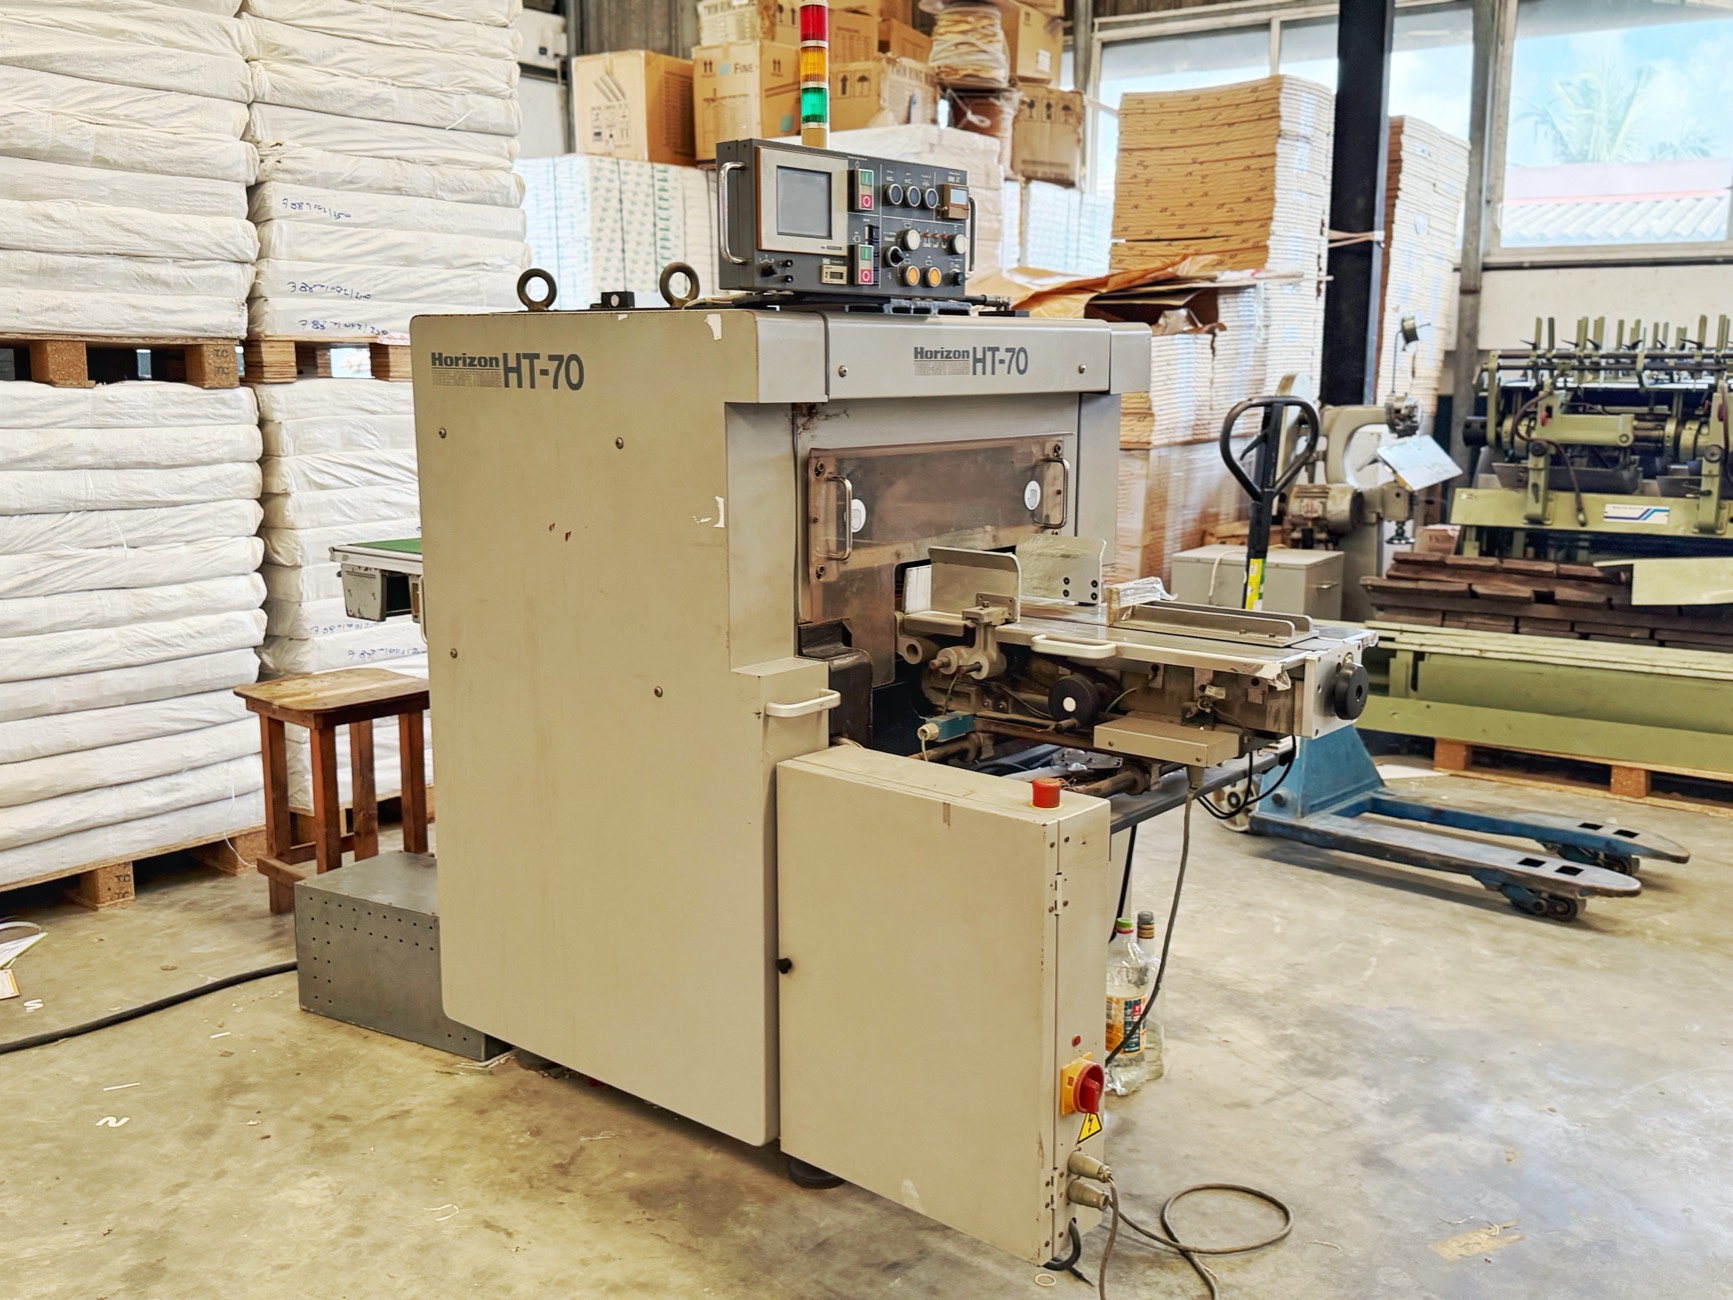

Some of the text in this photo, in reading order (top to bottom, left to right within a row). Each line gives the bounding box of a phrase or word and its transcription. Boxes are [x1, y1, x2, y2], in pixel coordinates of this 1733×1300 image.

[431, 352, 500, 368] Horizon
[502, 352, 585, 391] HT-70
[913, 346, 970, 360] Horizon
[972, 346, 1029, 376] HT-70
